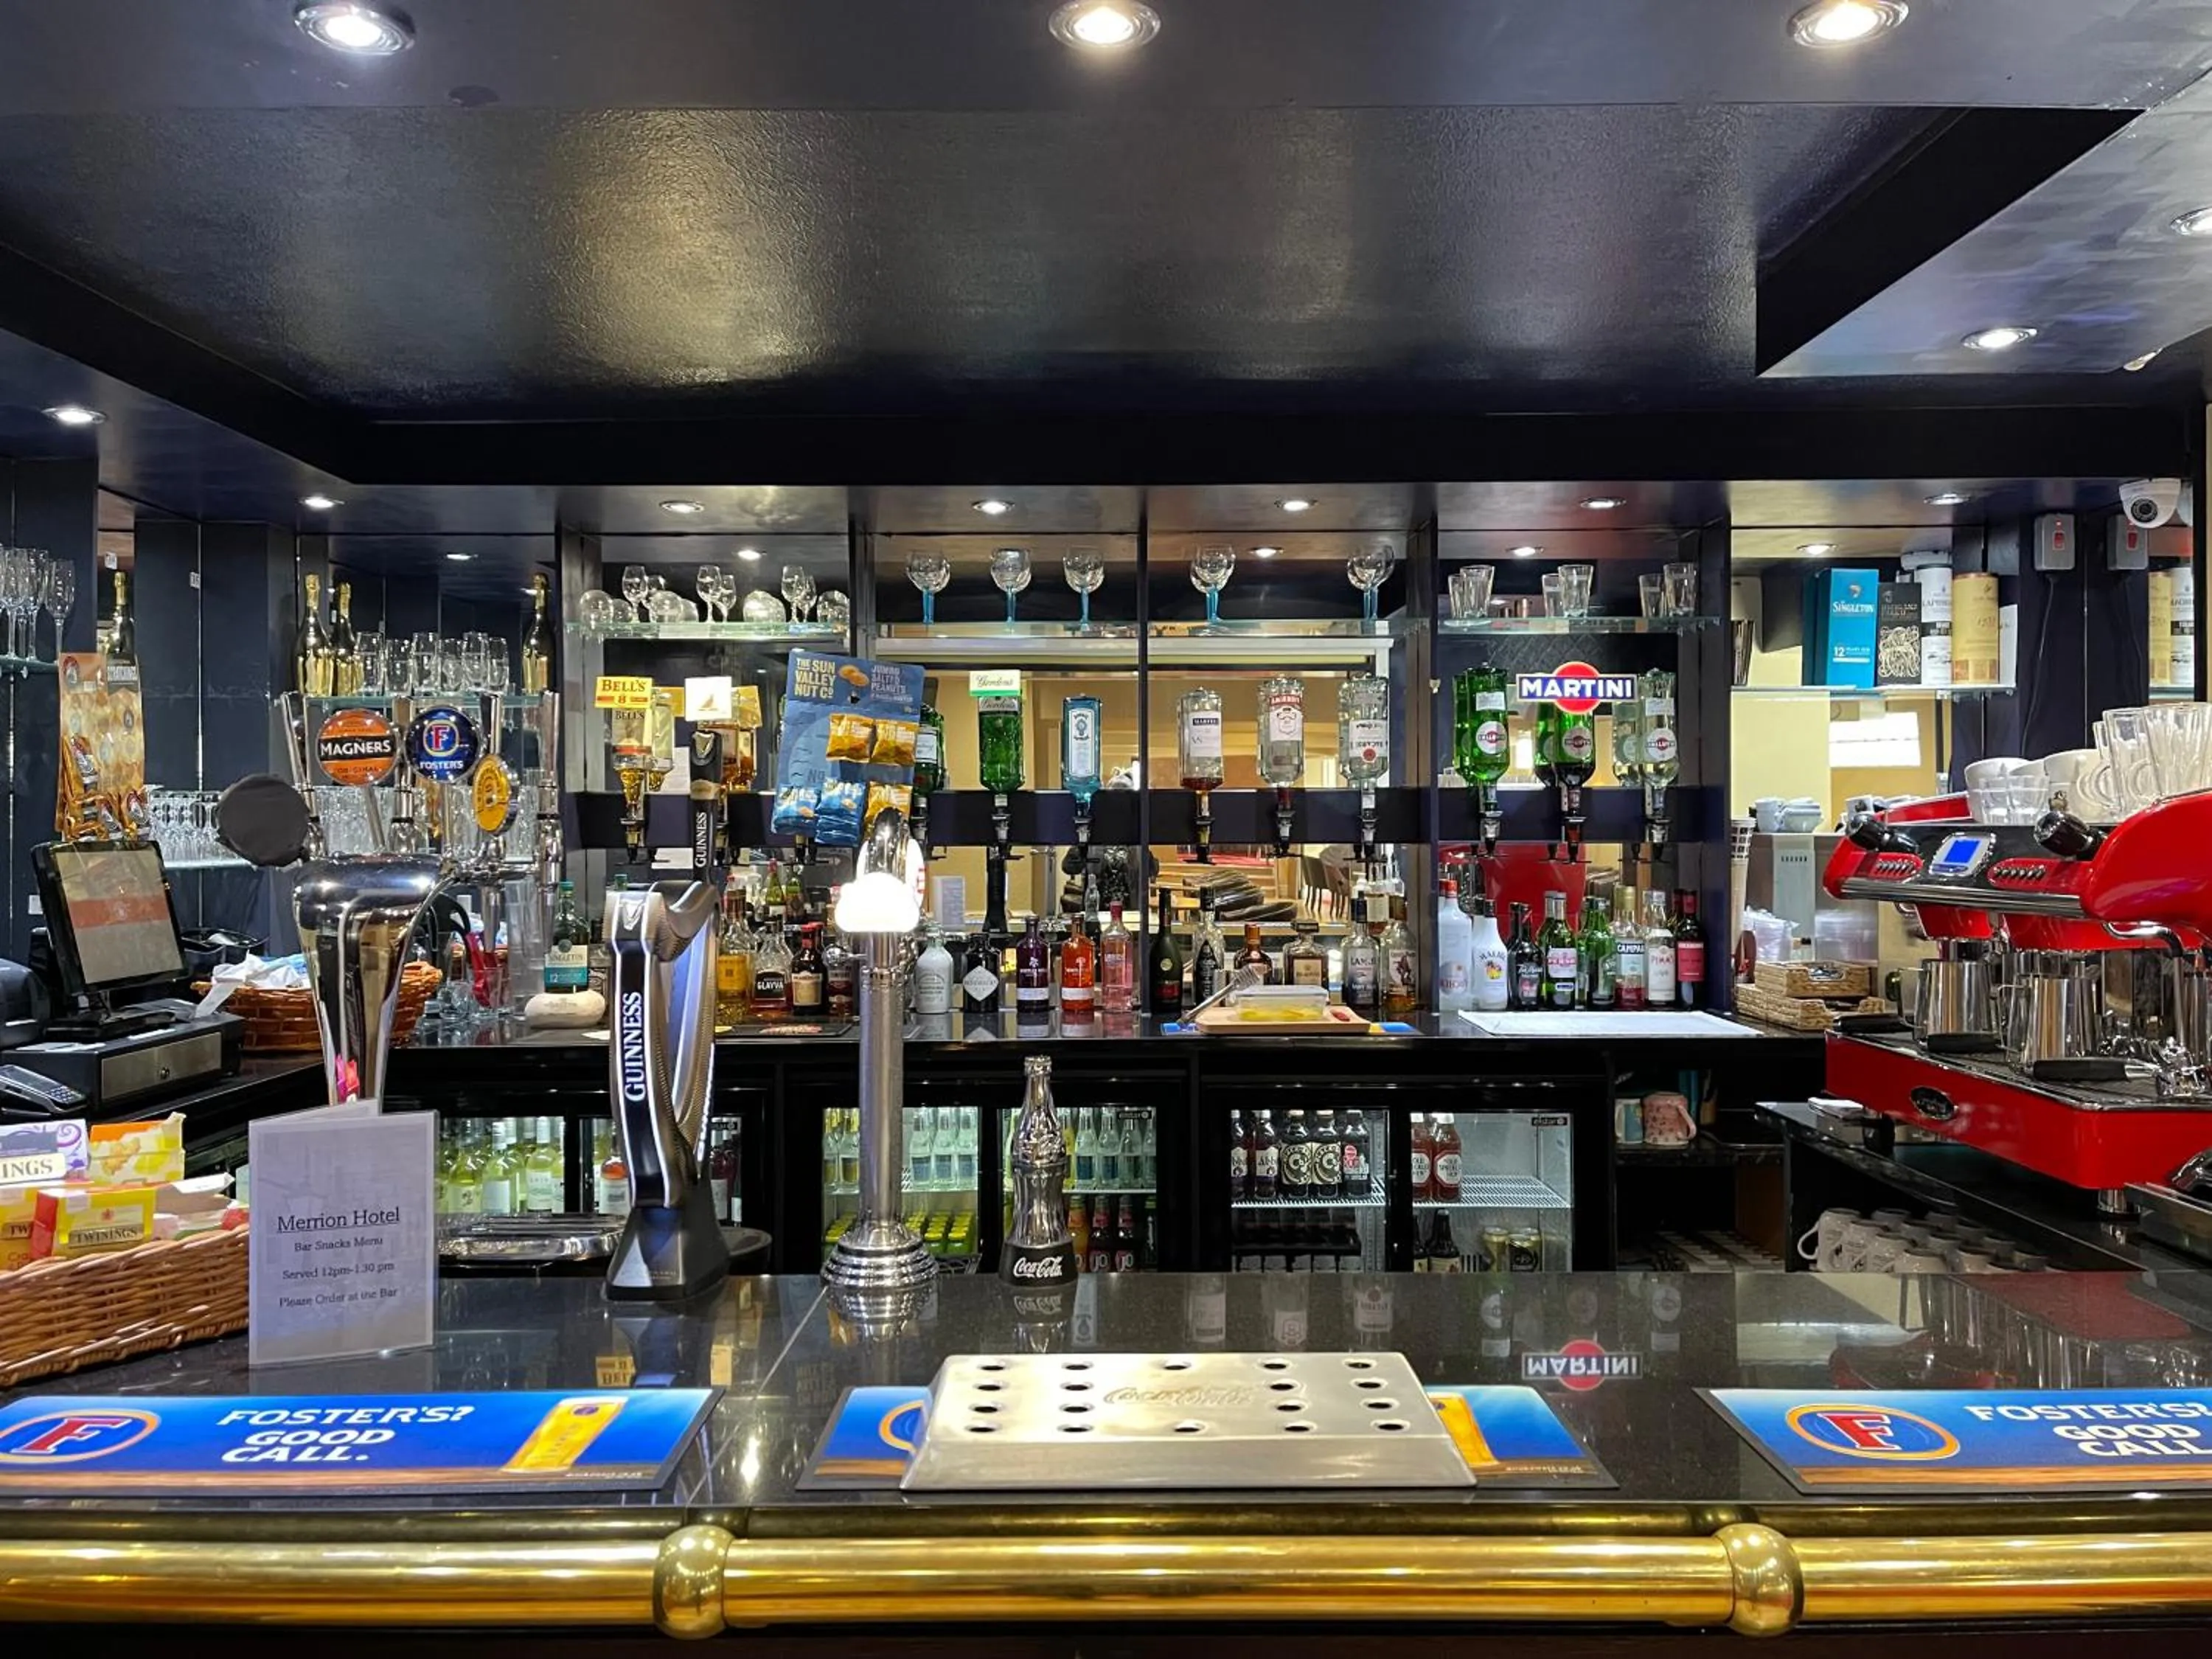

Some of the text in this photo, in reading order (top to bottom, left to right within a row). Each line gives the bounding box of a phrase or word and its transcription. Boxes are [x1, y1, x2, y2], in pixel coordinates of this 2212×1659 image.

[1834, 646, 1846, 658] 12
[812, 660, 835, 675] SUN
[602, 679, 646, 692] BELL'S
[795, 669, 837, 686] VALLEY
[794, 684, 818, 698] NUT
[1521, 678, 1632, 698] MARTINI
[616, 710, 645, 720] BELL'S
[432, 724, 450, 751] F
[320, 740, 392, 757] MAGNERS
[695, 812, 707, 868] GUINNESS
[757, 981, 785, 990] GLAYVA
[622, 992, 646, 1102] GUINNESS
[1, 1159, 53, 1179] INGS
[277, 1206, 400, 1232] Merrion Hotel
[76, 1227, 138, 1244] TWININGS
[294, 1237, 383, 1252] Bar Snacks Menu
[282, 1267, 318, 1279] Served
[378, 1263, 395, 1273] pm
[1013, 1256, 1063, 1278] Coca-Cola
[279, 1288, 398, 1307] Please Order at the Bar
[217, 1405, 476, 1428] FOSTER'S?
[245, 1428, 396, 1446] GOOD
[1817, 1412, 1902, 1453] F
[2053, 1424, 2201, 1439] GOOD
[221, 1445, 369, 1463] CALL.
[2077, 1439, 2212, 1457] CALL
